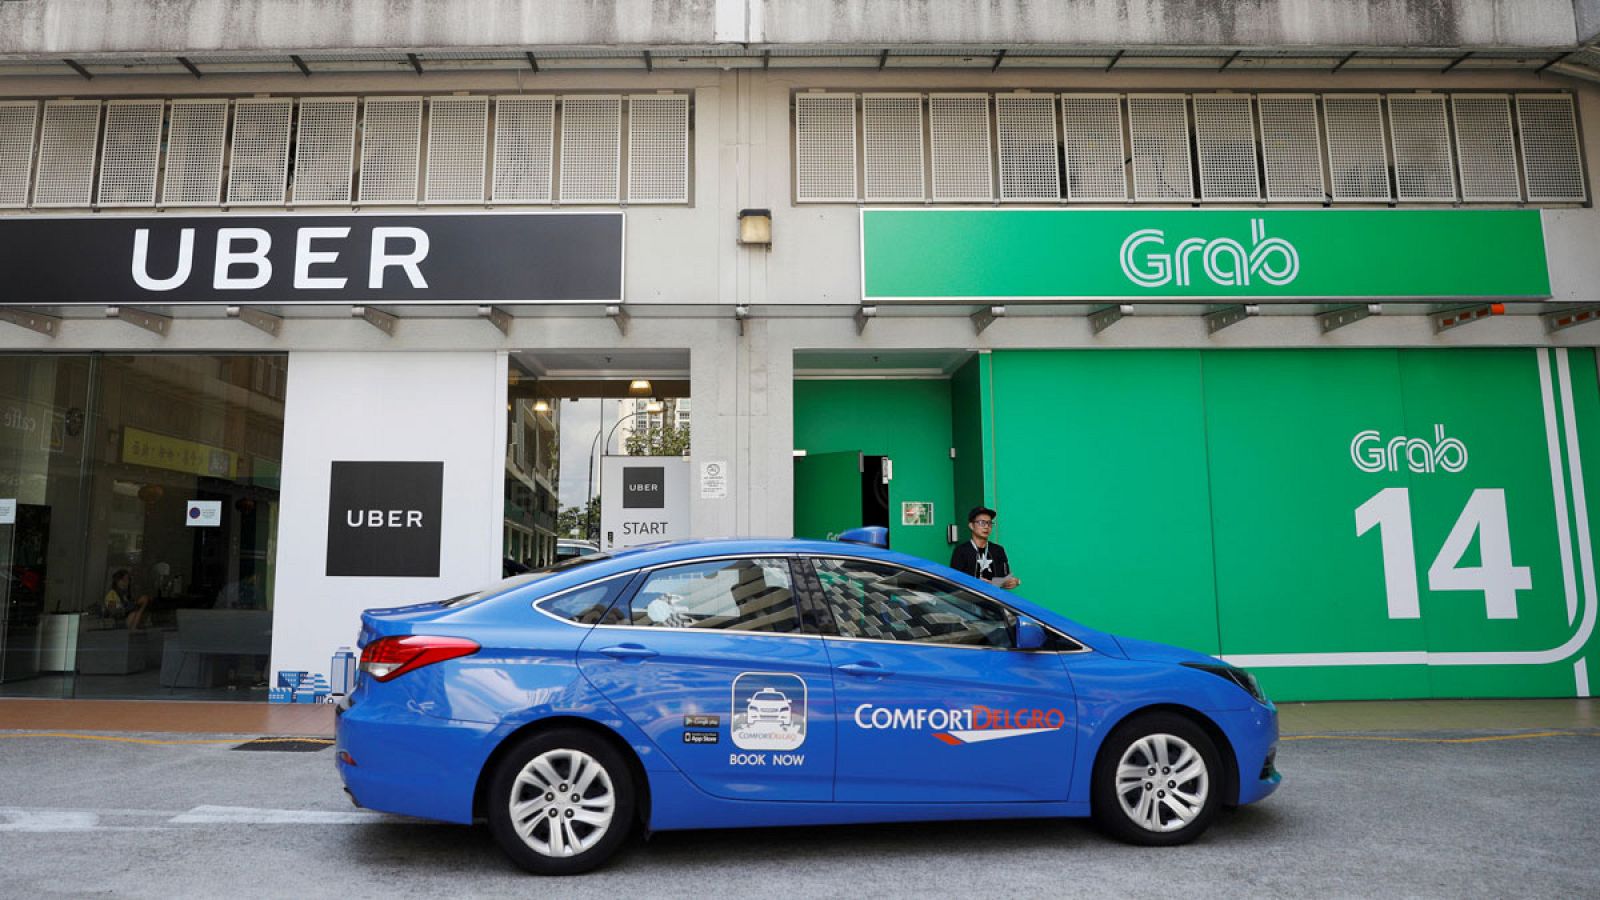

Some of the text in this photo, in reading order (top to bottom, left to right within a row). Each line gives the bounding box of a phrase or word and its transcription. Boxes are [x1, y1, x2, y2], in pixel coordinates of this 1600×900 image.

[131, 226, 430, 292] UBER
[1119, 218, 1300, 288] Grab
[1350, 423, 1469, 473] Grab
[628, 483, 658, 492] UBER
[347, 509, 423, 528] UBER
[623, 521, 668, 536] START
[1354, 487, 1533, 619] 14
[729, 754, 805, 766] BOOK NOW
